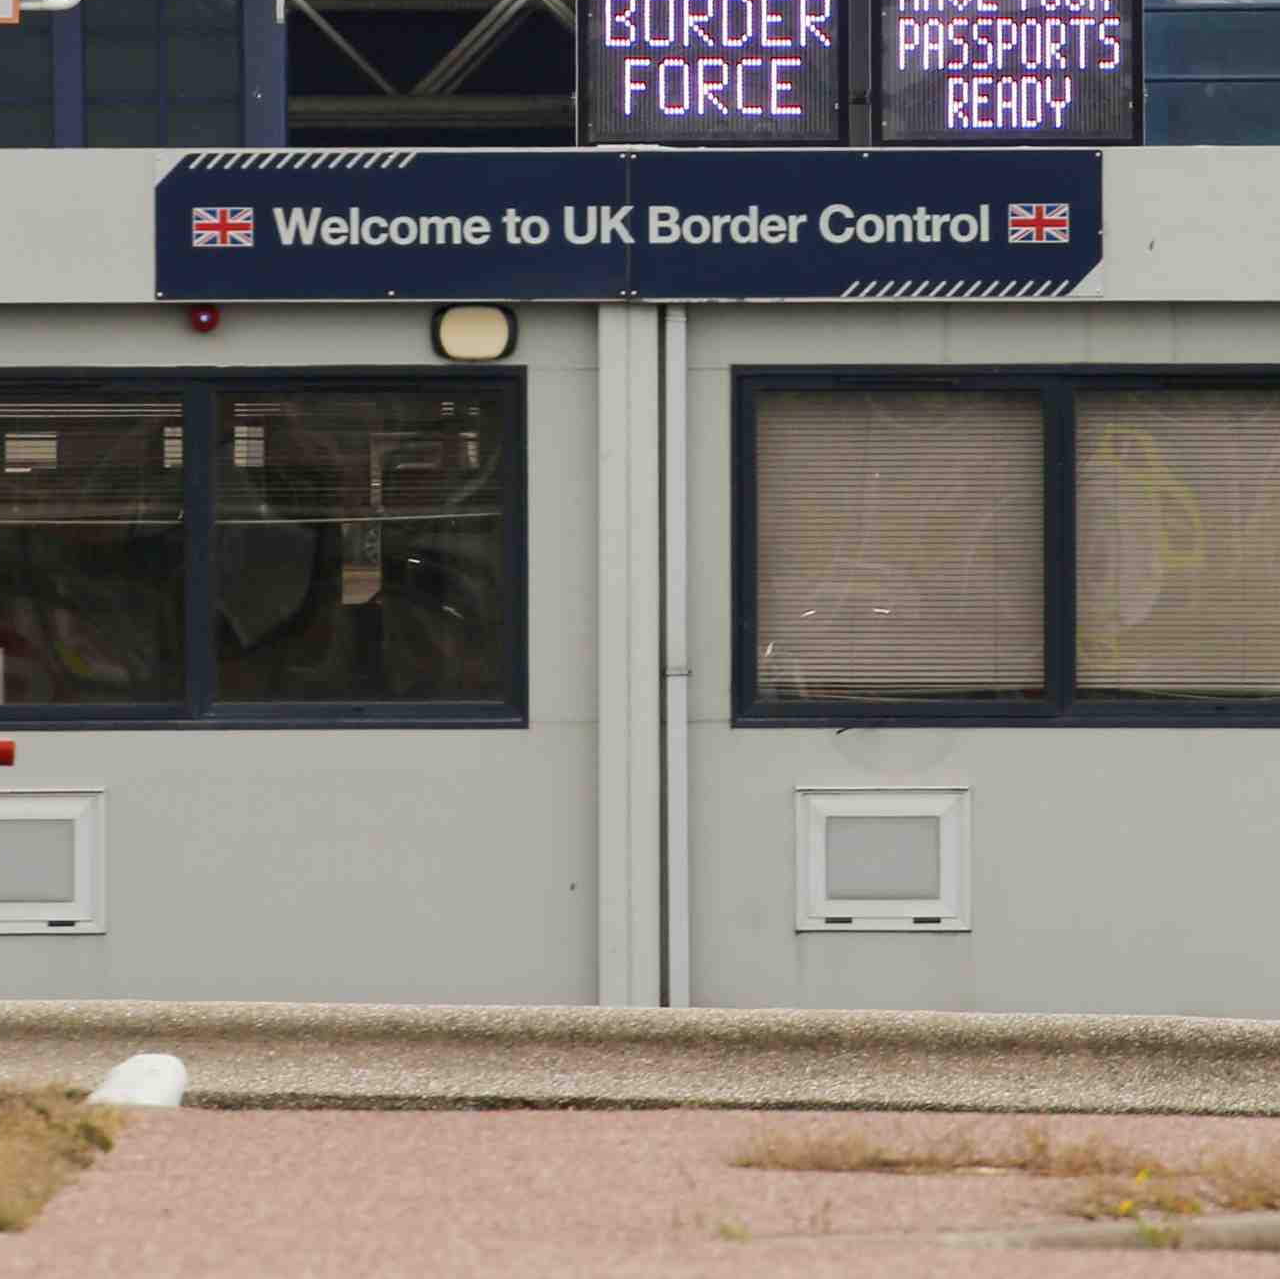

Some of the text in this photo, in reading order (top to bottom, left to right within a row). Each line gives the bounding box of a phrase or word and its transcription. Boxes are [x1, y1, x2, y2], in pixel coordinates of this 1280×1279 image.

[895, 17, 1122, 71] PASSPORTS
[622, 56, 803, 116] FORCE
[945, 75, 1073, 130] READY
[273, 204, 990, 245] Welcome to UK Border Control
